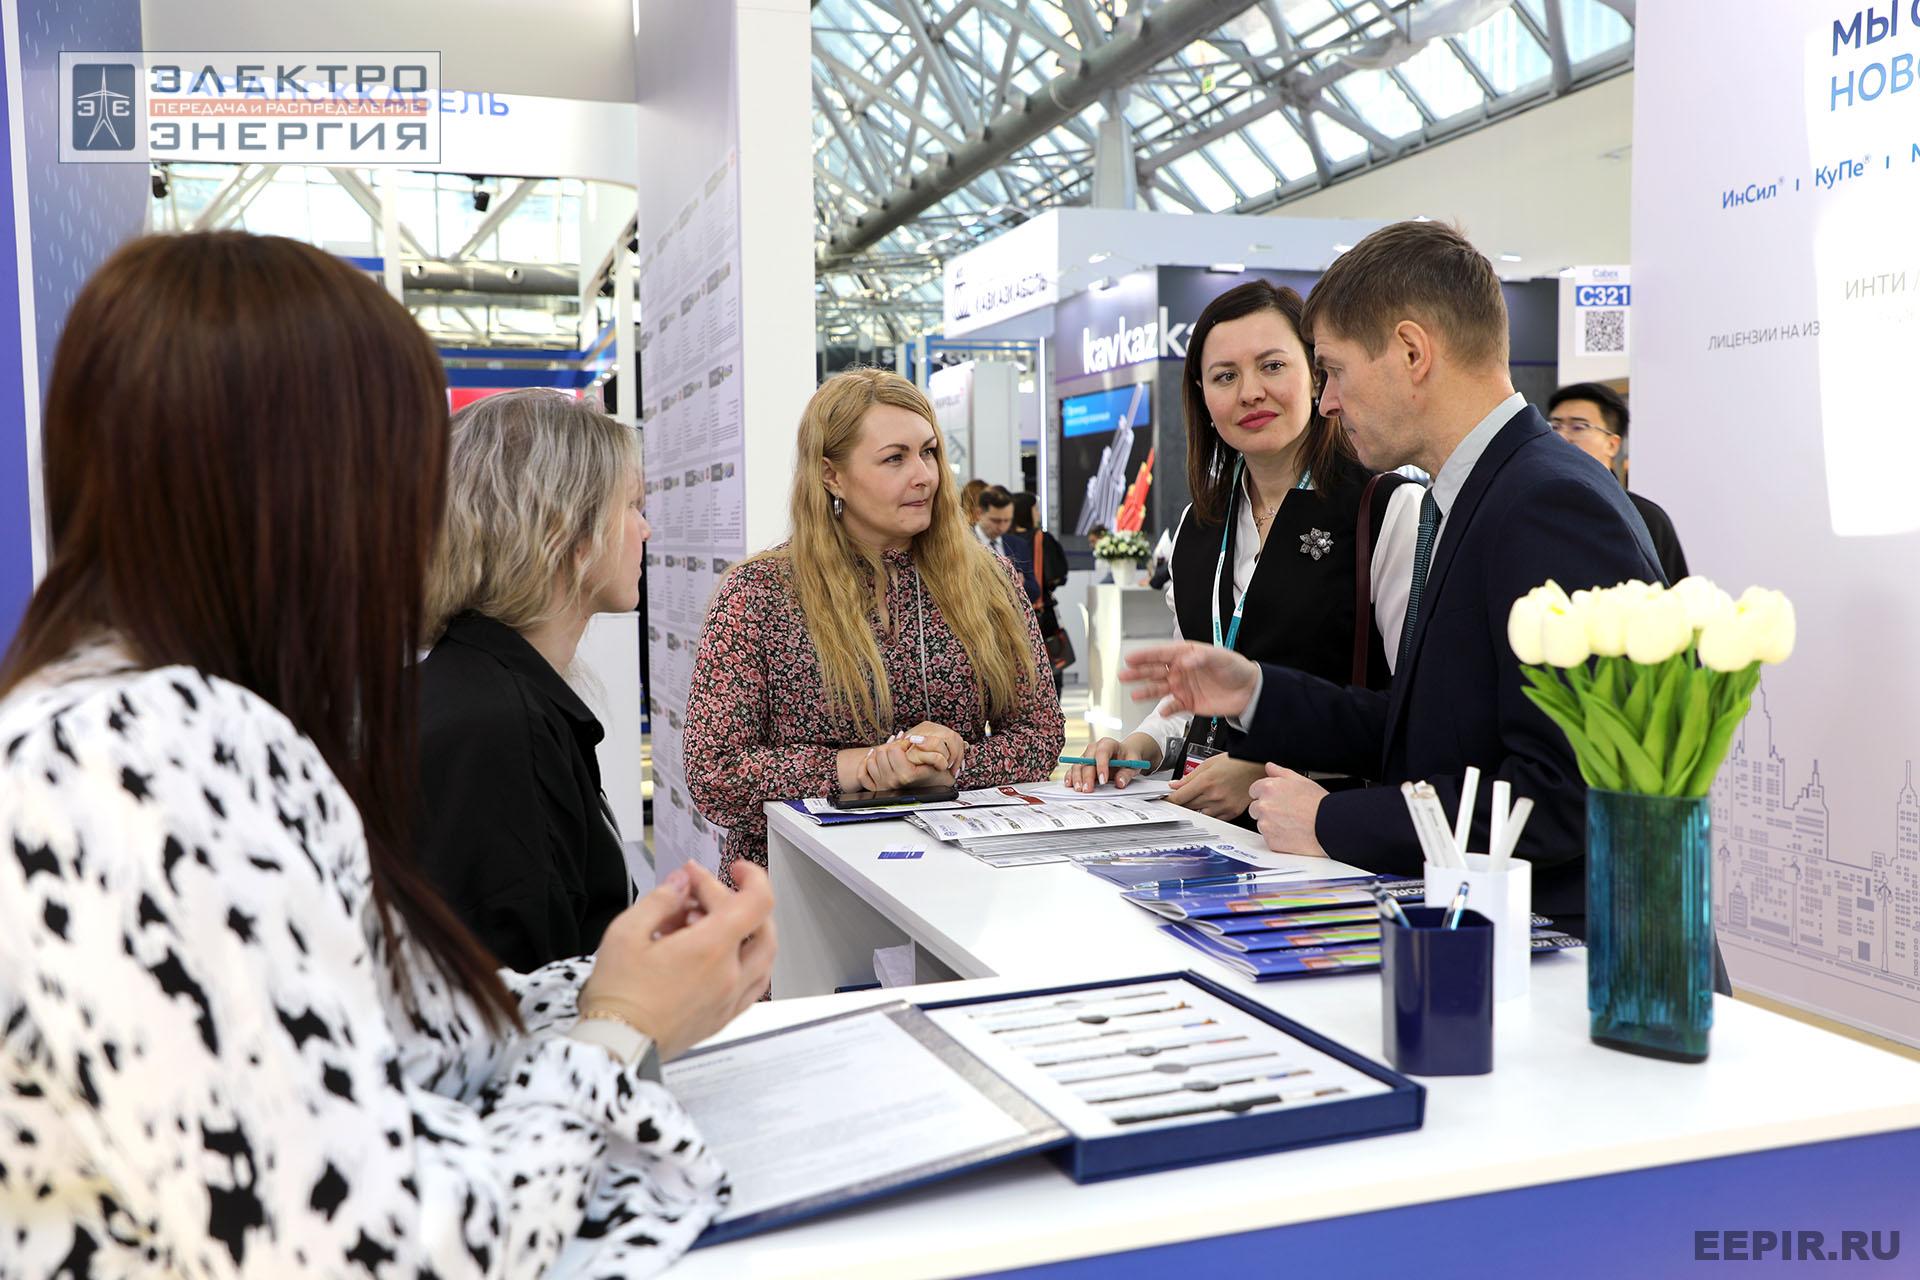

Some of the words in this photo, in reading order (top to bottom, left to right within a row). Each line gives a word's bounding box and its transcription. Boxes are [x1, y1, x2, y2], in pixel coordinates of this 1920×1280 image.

[1832, 0, 1898, 56] МЫ
[1831, 53, 1920, 112] НОВ
[1579, 286, 1628, 305] C321
[1845, 271, 1906, 300] ИНТИ
[1708, 328, 1778, 351] ЛИЦЕНЗИИ
[1781, 324, 1800, 341] НА
[1803, 321, 1820, 336] ИЗ
